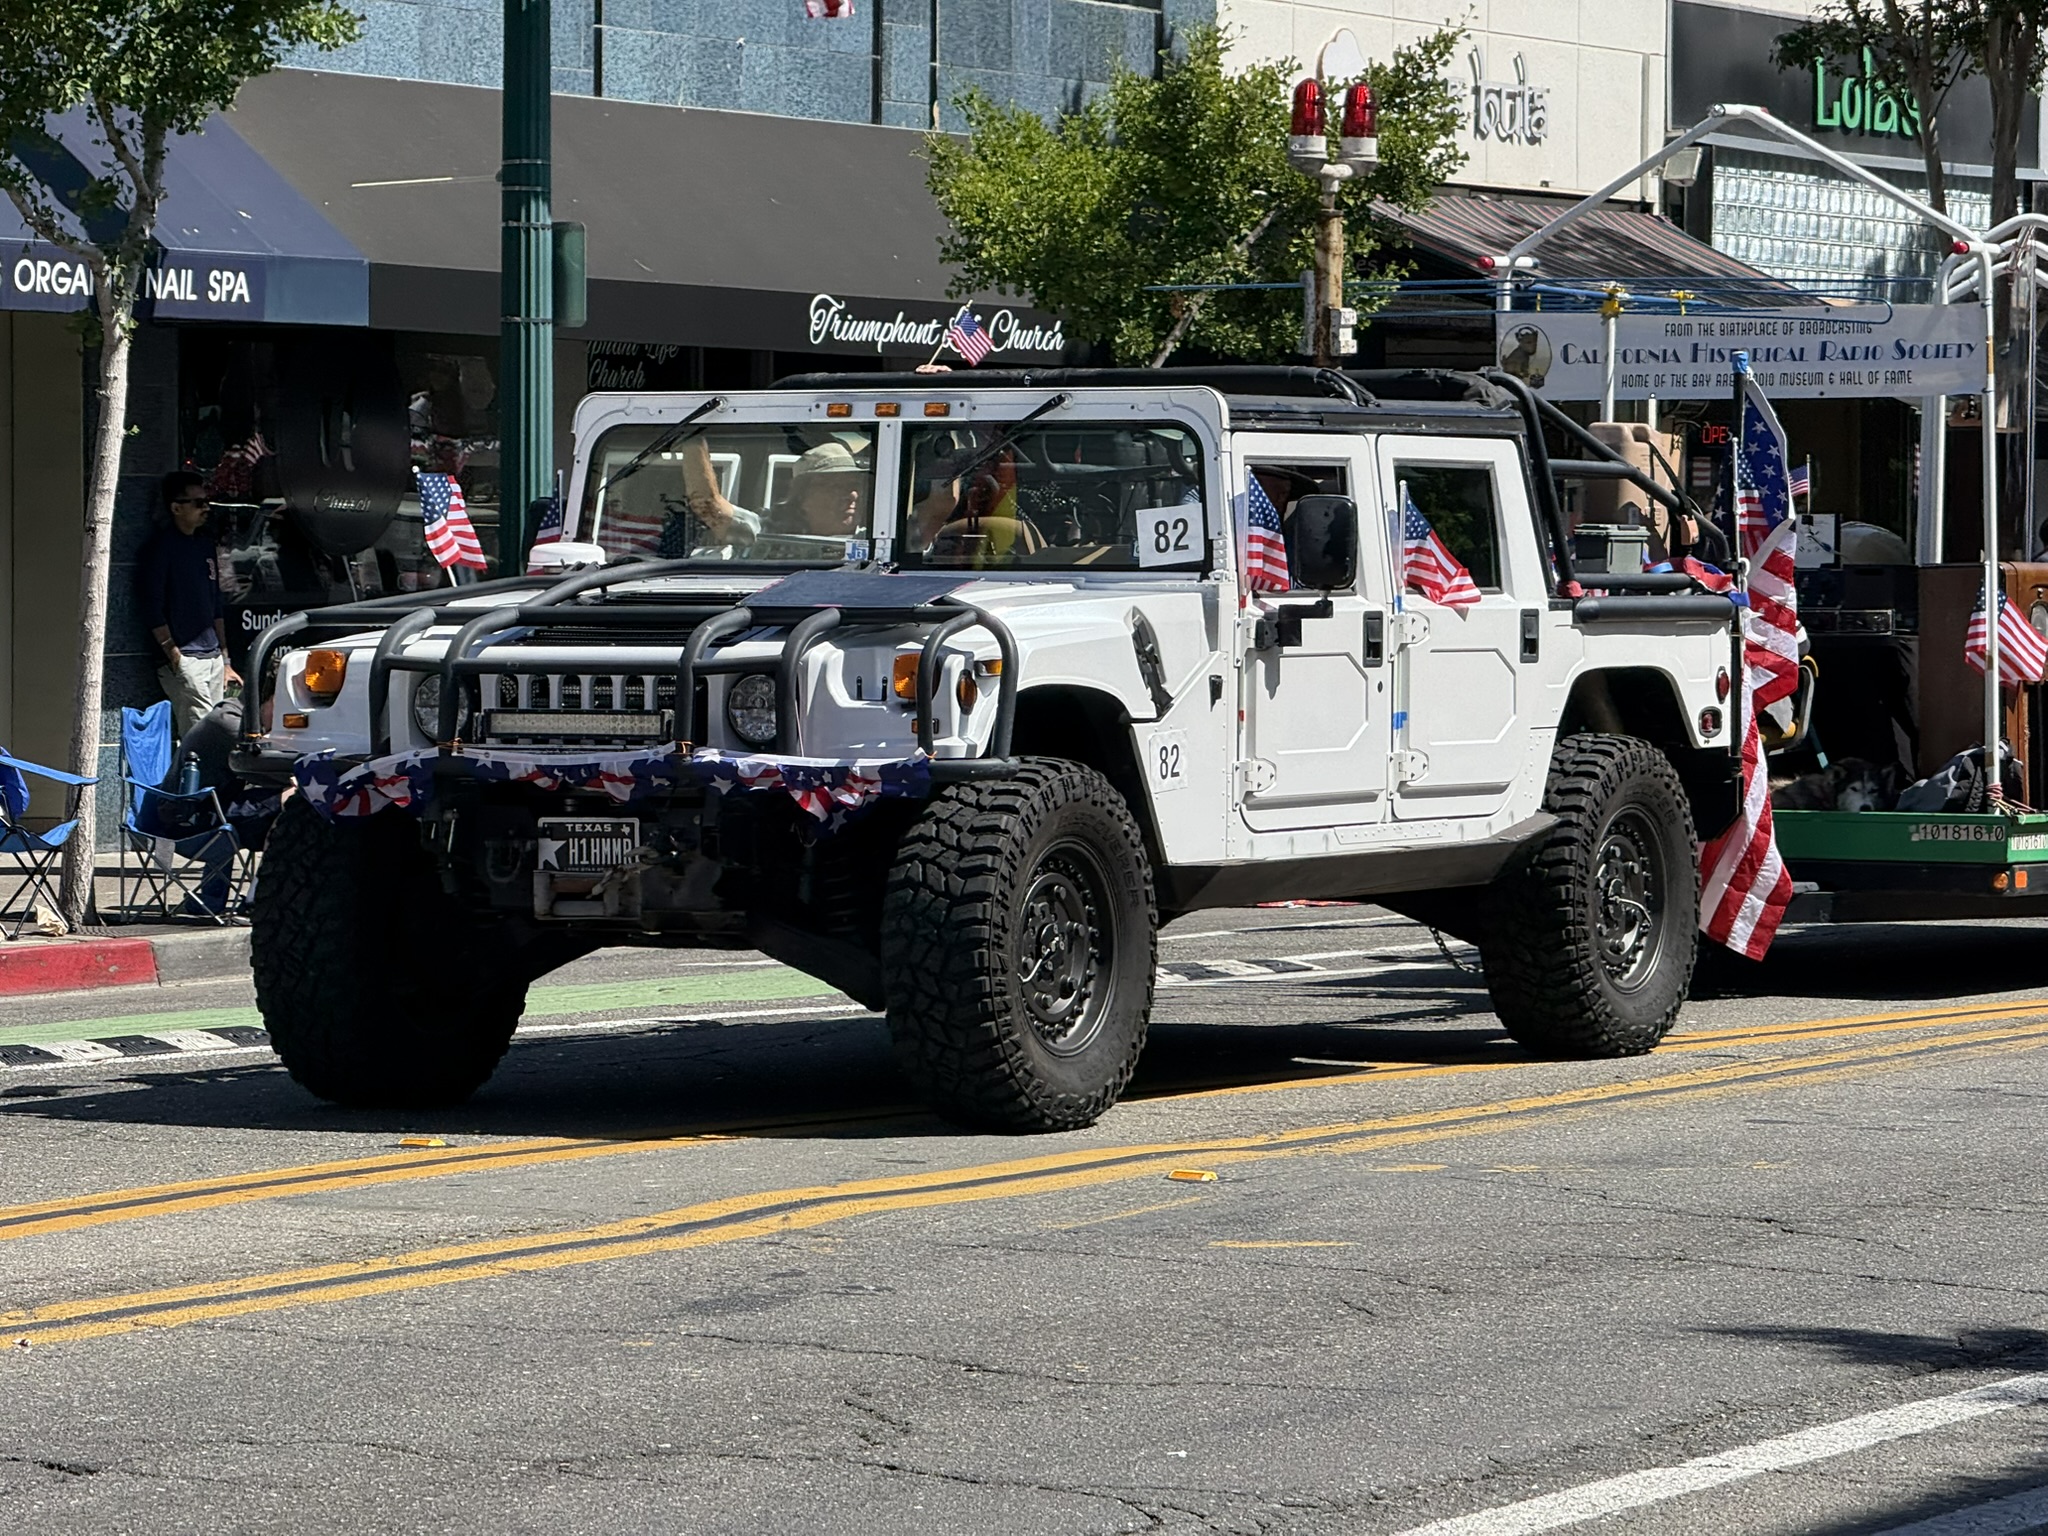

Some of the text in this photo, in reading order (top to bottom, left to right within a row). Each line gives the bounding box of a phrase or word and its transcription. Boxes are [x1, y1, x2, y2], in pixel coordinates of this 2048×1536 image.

[145, 268, 198, 300] NAIL
[208, 269, 250, 303] SPA
[810, 294, 942, 352] Triumphant
[988, 309, 1066, 352] Church
[1665, 321, 1873, 337] FROM THE BIRTHPLACE OF BROADCASTING
[1560, 338, 1979, 364] CALORNIA HISTRICAL RADIO SOCIETY
[588, 359, 646, 389] Church
[1622, 374, 1650, 388] HOME
[1654, 374, 1666, 388] OF
[1670, 374, 1687, 388] THE
[1692, 373, 1712, 388] BAY
[1716, 373, 1734, 387] ARE
[1779, 372, 1824, 386] MUSEUM
[1840, 371, 1864, 385] HALL
[1868, 371, 1880, 385] OF
[1885, 370, 1912, 384] FAME
[1702, 426, 1728, 443] OPE
[1154, 517, 1190, 554] 82
[1159, 743, 1180, 780] 82
[565, 823, 612, 832] TEXAS
[569, 838, 632, 865] H1HMMR
